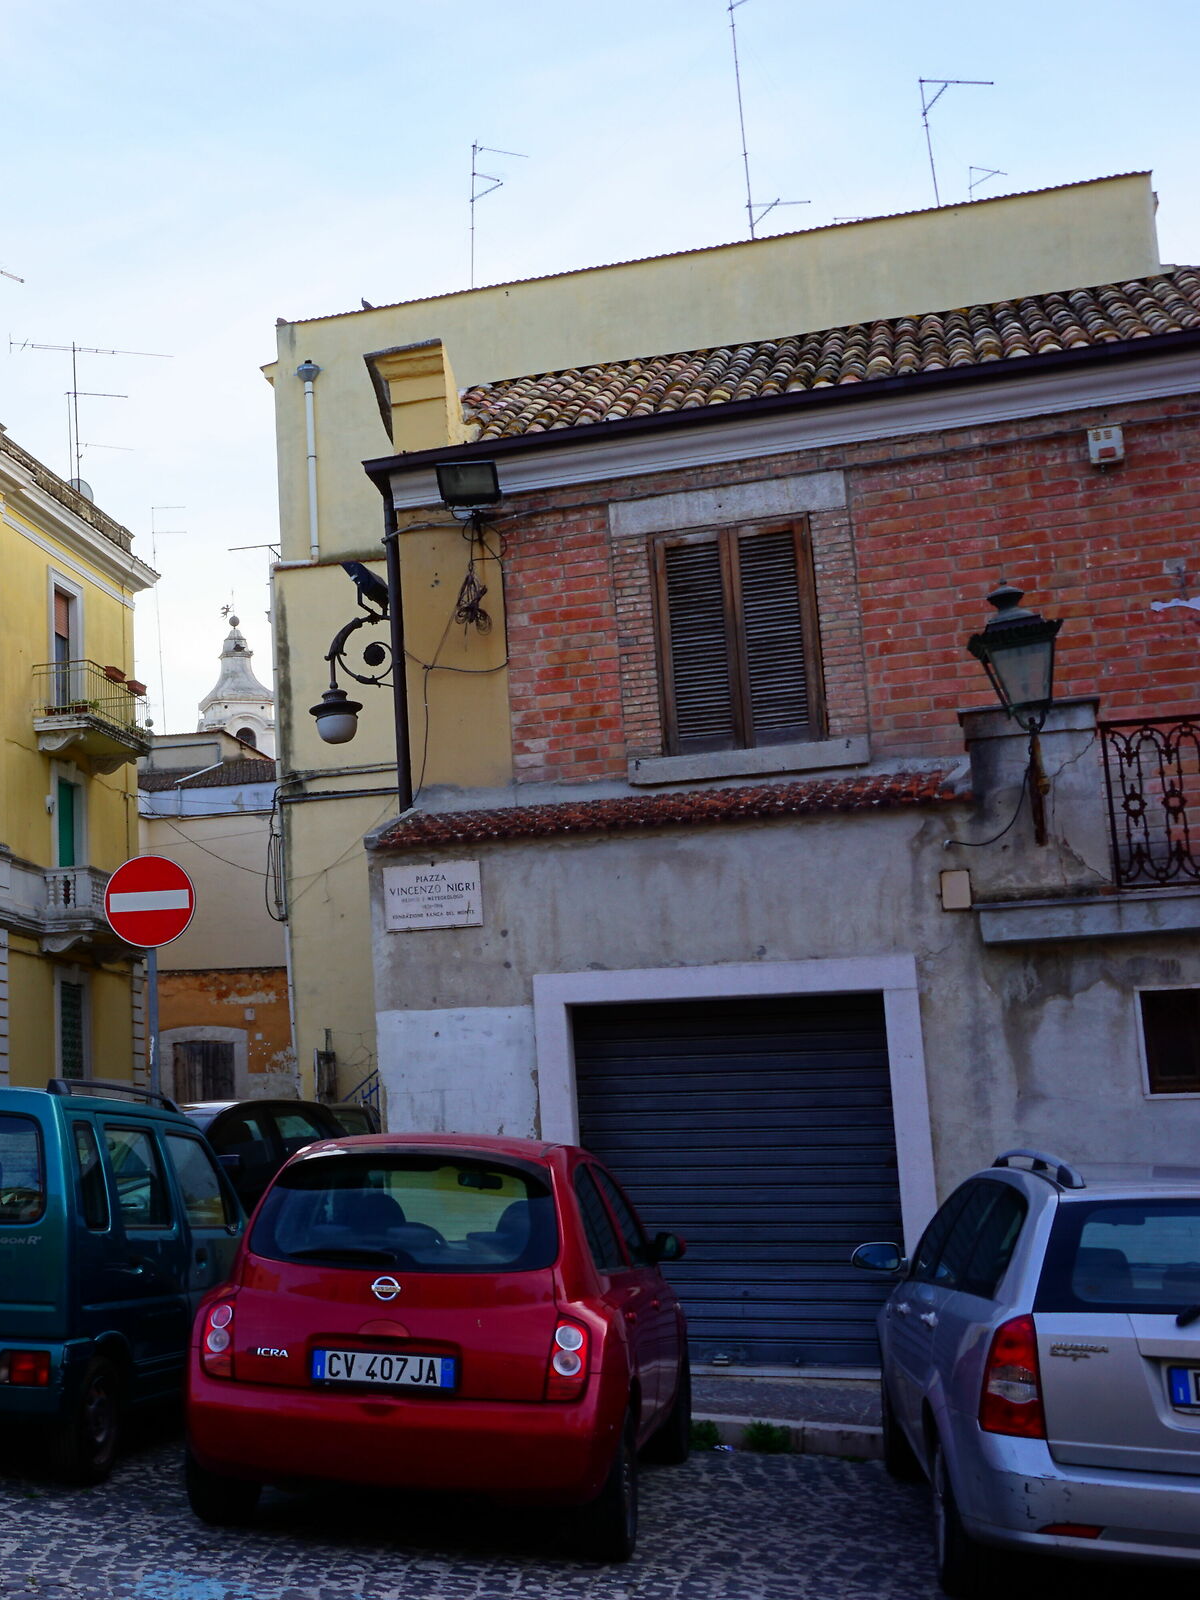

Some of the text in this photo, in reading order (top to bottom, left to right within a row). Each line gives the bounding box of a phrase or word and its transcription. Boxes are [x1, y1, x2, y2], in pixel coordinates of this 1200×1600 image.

[416, 874, 446, 883] PIAZZA
[389, 881, 475, 896] VINCENZO NIGRI
[248, 1347, 289, 1358] ICRA
[328, 1353, 356, 1378] CV
